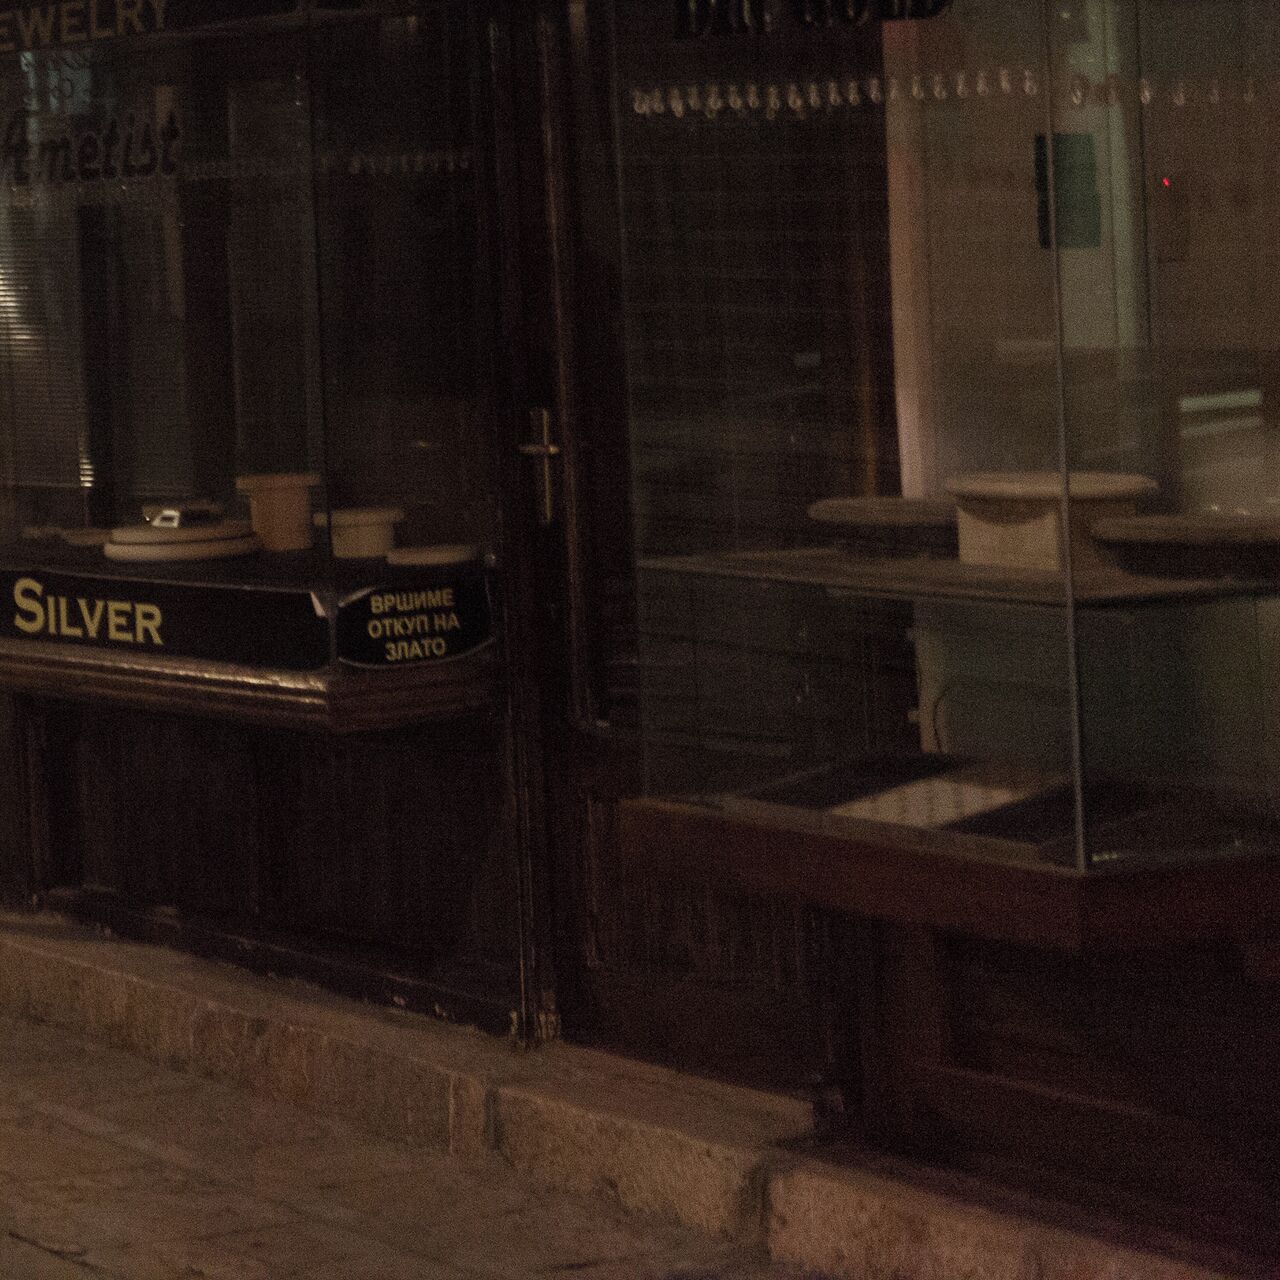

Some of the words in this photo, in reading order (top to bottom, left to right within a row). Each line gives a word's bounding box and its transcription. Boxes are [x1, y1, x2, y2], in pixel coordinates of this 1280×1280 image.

[370, 587, 455, 614] ВРШИМЕ
[367, 614, 429, 638] ОТКУП
[433, 611, 460, 632] НА
[384, 637, 446, 661] ЗЛАТО
